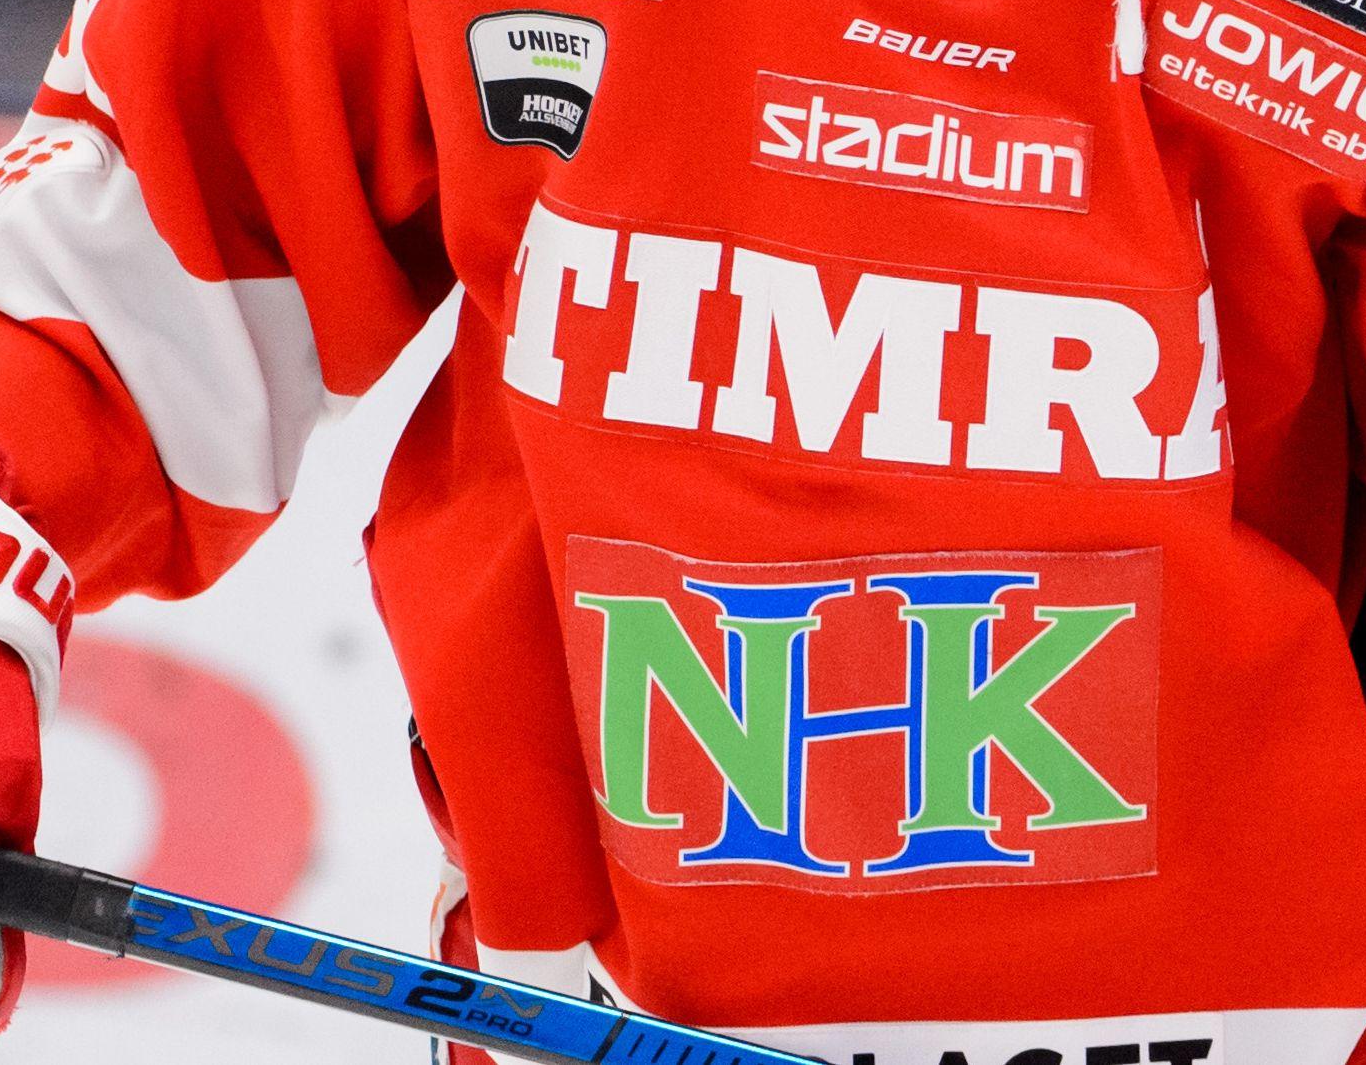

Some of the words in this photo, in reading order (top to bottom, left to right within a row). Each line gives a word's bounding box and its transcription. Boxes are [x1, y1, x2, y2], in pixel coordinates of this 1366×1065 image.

[507, 29, 591, 60] UNIBET
[842, 17, 1017, 73] BAUER
[523, 93, 584, 125] HOCKEY
[1160, 53, 1315, 136] elteknik
[759, 95, 1085, 198] stadium
[573, 571, 1148, 879] NHK
[464, 1008, 534, 1037] PRO
